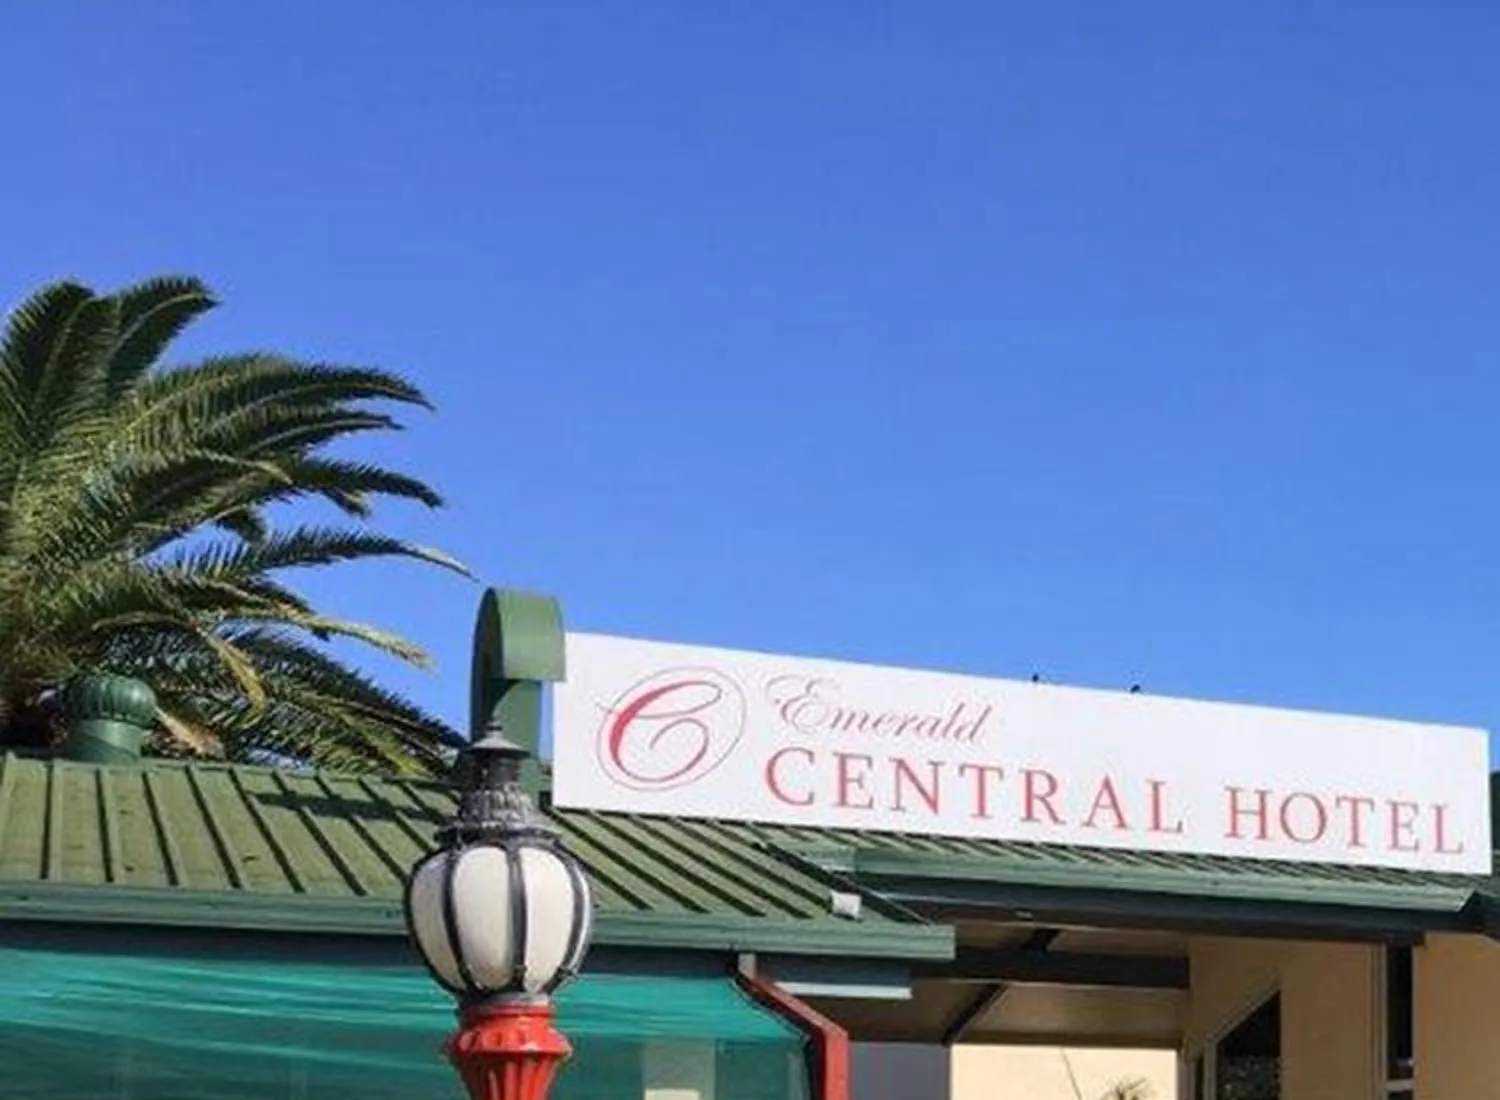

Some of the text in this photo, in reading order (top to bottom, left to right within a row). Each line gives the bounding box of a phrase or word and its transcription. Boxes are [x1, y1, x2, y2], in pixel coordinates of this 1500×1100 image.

[769, 675, 998, 747] Emerald
[765, 747, 1465, 856] CENTRAL HOTEL
